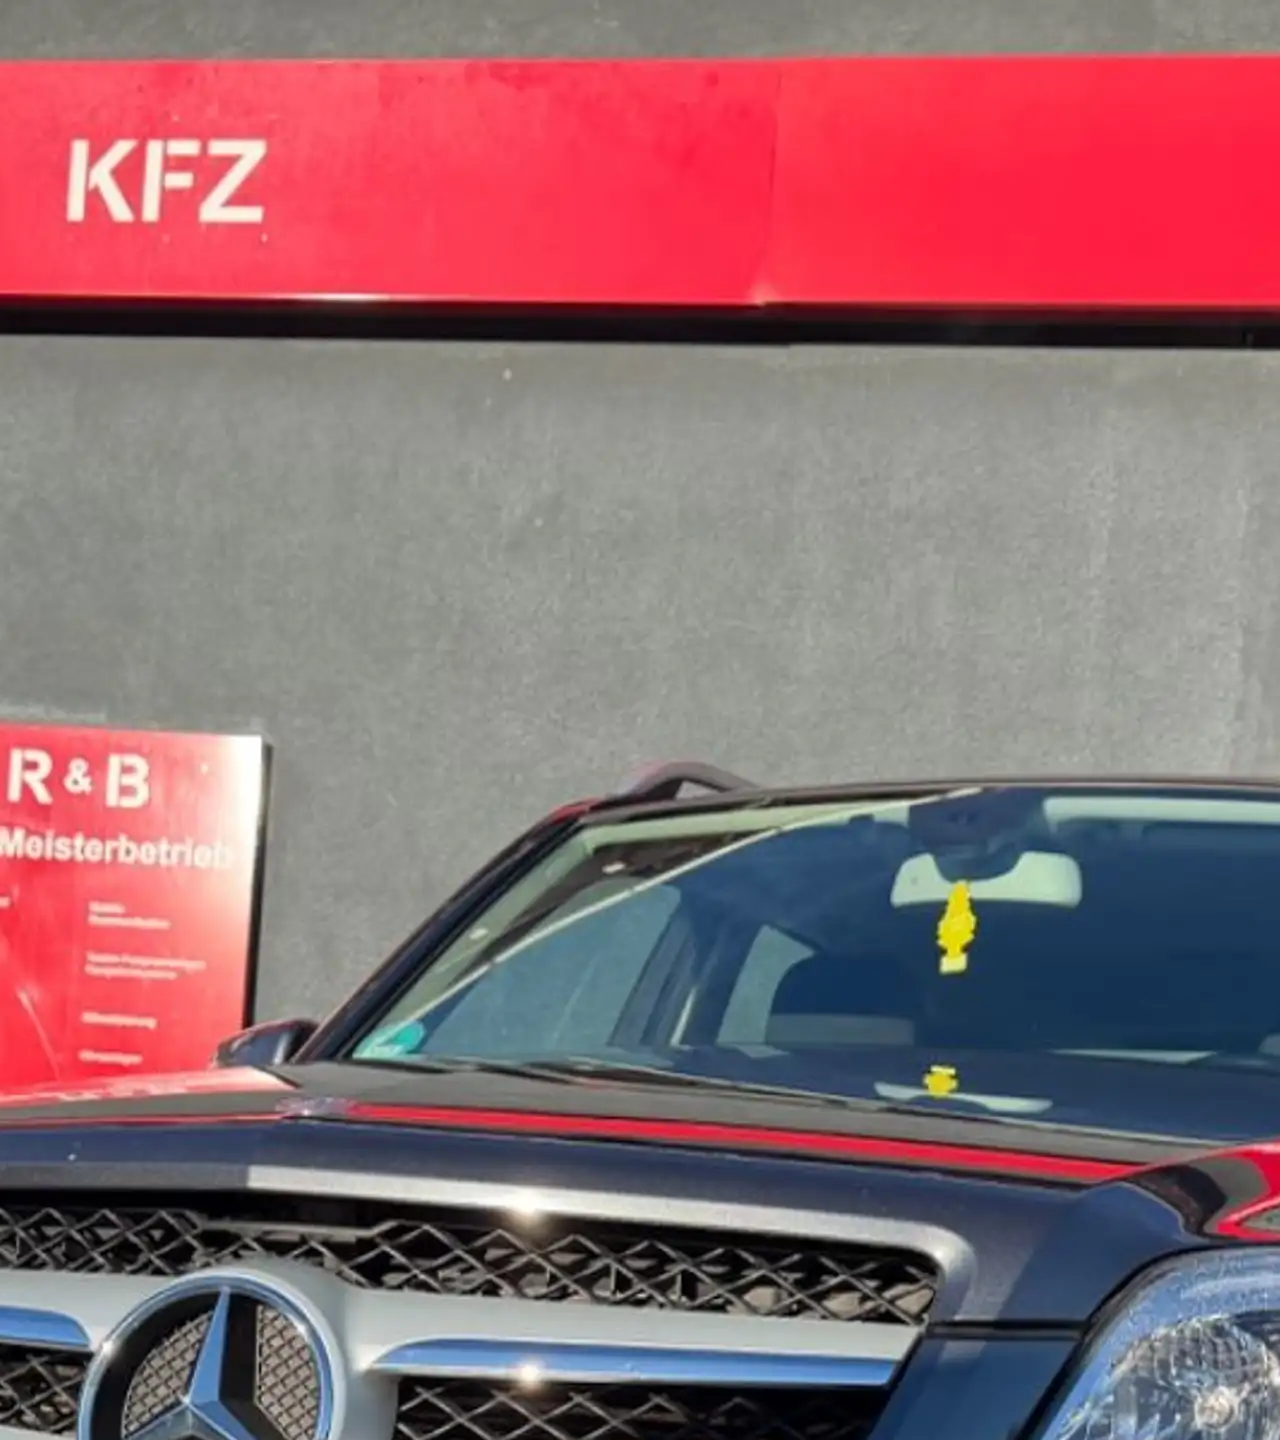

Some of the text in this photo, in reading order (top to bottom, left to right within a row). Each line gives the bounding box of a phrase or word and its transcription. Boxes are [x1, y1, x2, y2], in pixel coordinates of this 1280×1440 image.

[66, 138, 269, 224] KFZ
[7, 748, 151, 808] R & B
